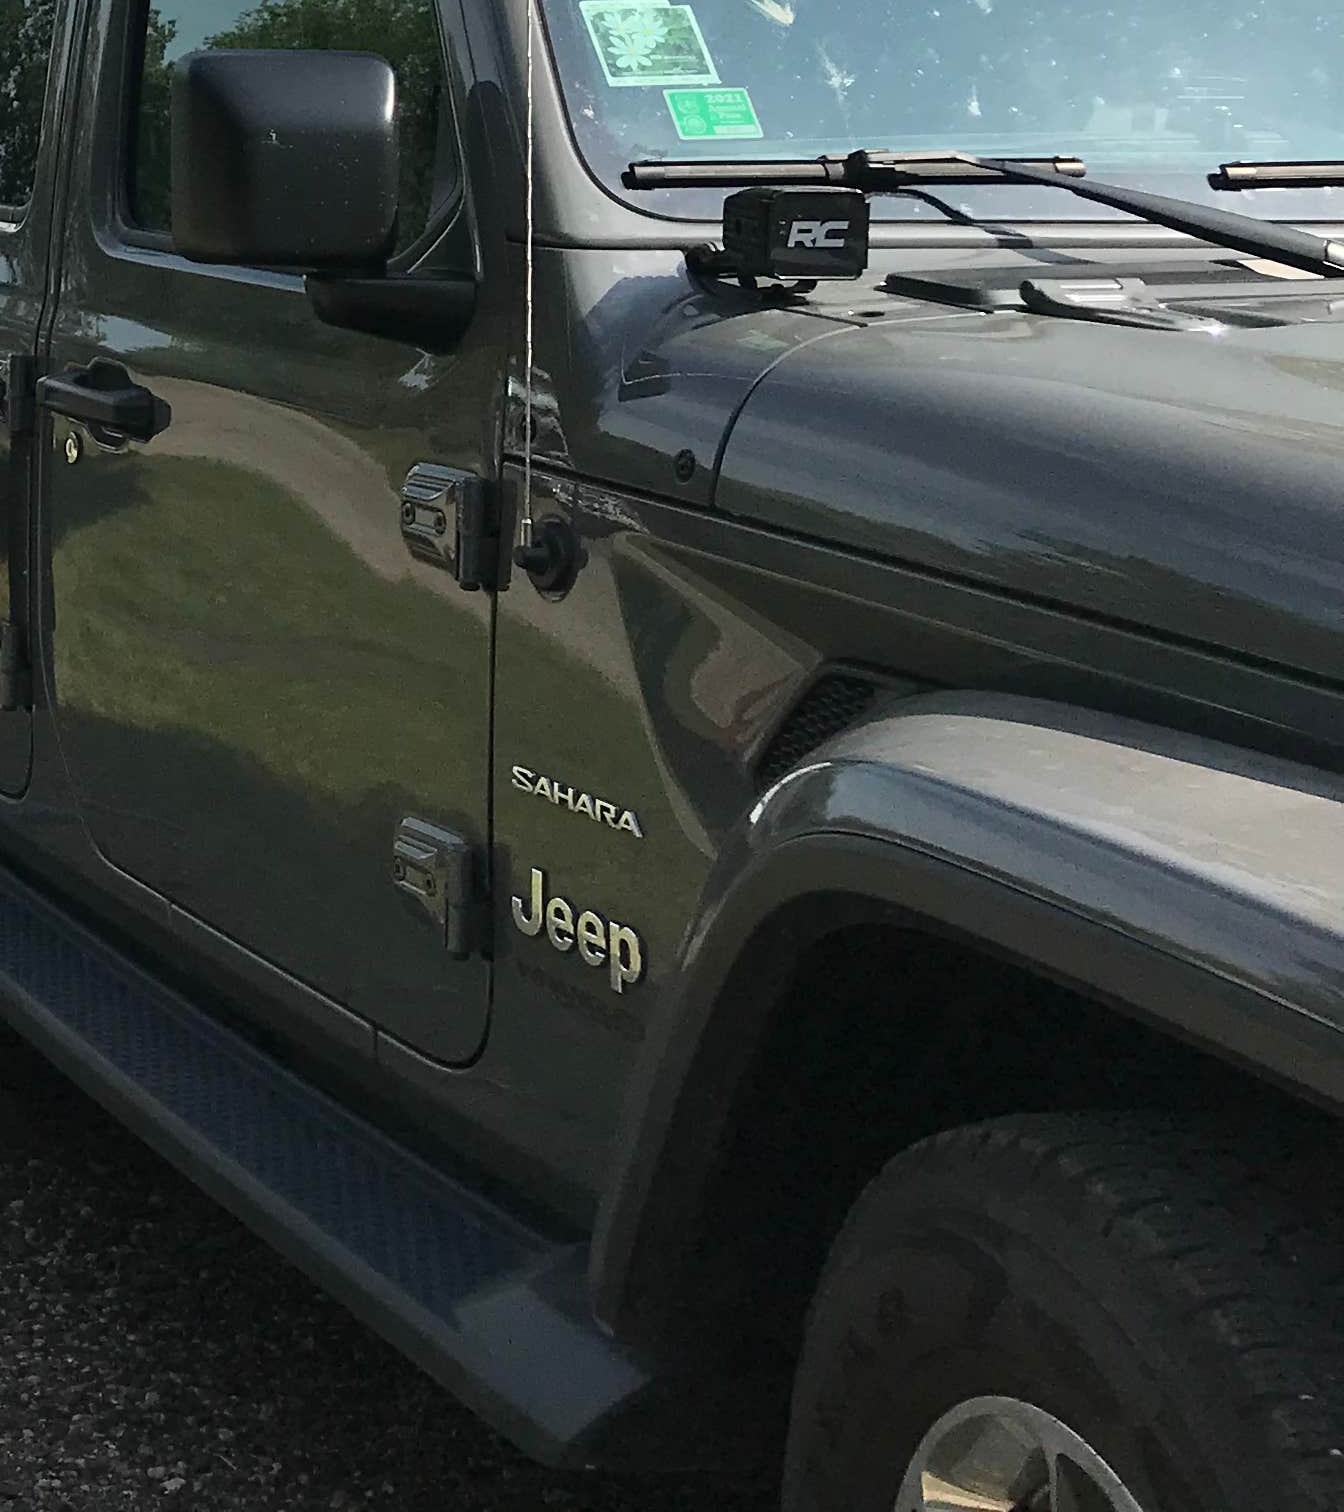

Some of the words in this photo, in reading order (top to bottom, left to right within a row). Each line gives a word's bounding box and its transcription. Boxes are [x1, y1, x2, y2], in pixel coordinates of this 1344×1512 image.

[787, 220, 850, 248] RC
[512, 765, 644, 838] SAHARA
[512, 868, 641, 994] Jeep
